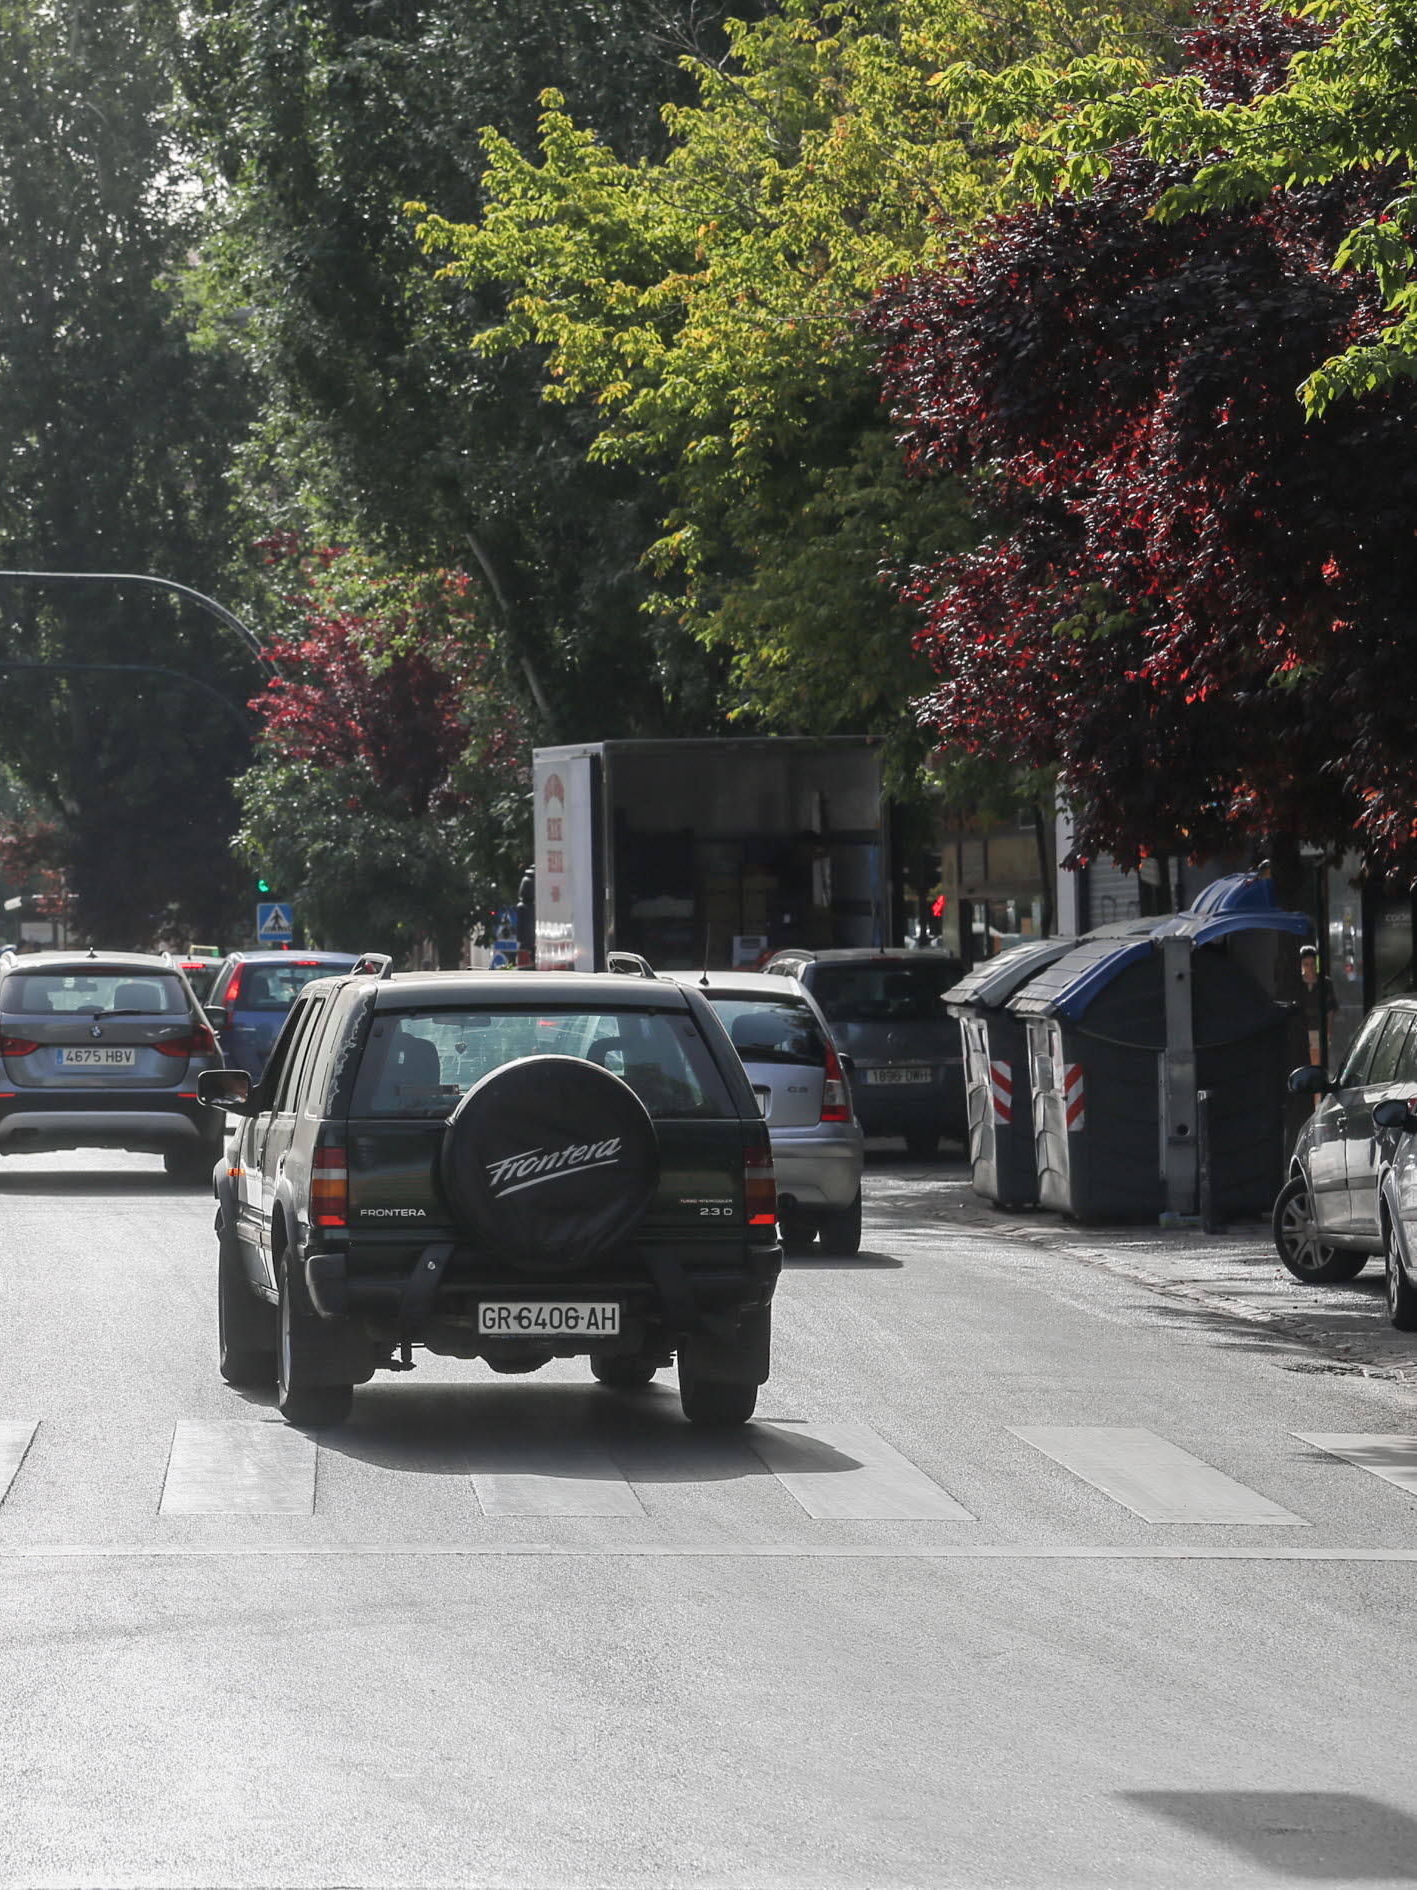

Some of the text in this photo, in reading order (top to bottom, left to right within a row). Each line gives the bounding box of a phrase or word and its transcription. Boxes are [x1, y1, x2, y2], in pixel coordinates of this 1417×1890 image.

[66, 1050, 132, 1063] 4675 HBV
[485, 1137, 622, 1187] Frontera
[360, 1208, 427, 1217] FRONTERA
[723, 1207, 733, 1216] D
